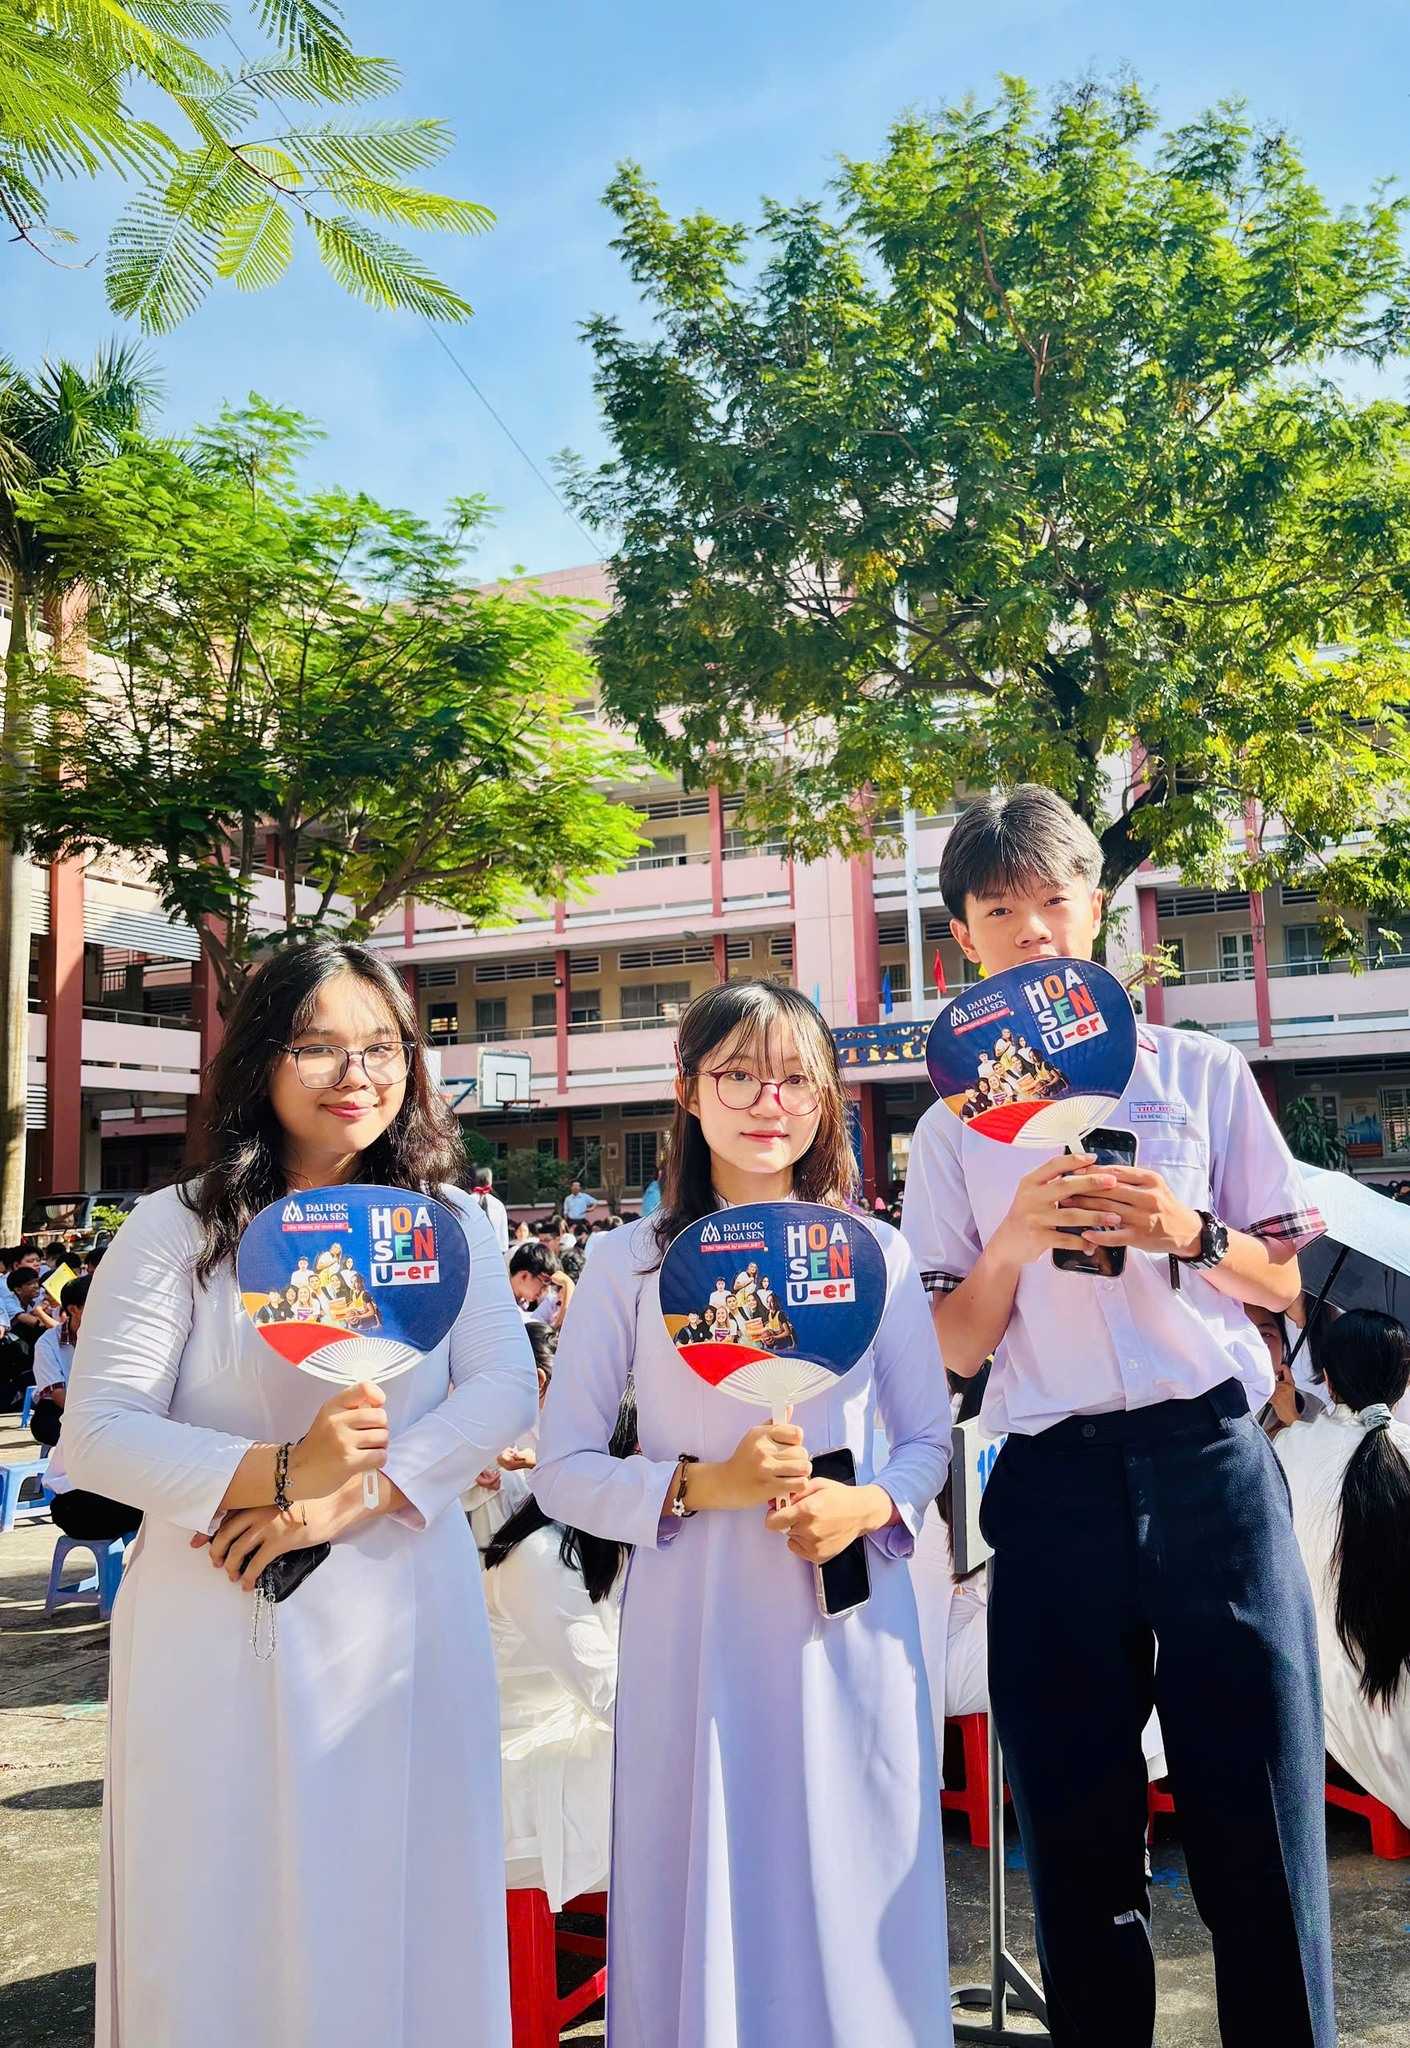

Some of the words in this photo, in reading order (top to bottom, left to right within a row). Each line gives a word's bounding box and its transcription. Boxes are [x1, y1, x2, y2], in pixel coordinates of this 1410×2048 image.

[1024, 967, 1083, 1013] HOA
[970, 1006, 990, 1019] HOA
[989, 998, 1008, 1011] SEN
[1038, 985, 1096, 1031] SEN
[1046, 1016, 1100, 1050] U-er
[306, 1213, 328, 1221] HOA
[329, 1212, 349, 1221] SEN
[371, 1206, 433, 1239] HOA
[373, 1228, 435, 1262] SEN
[723, 1232, 745, 1241] HOA
[746, 1231, 765, 1240] SEN
[786, 1222, 848, 1257] HOA
[375, 1265, 435, 1284] U-er
[789, 1245, 850, 1280] SEN
[791, 1283, 850, 1303] U-er
